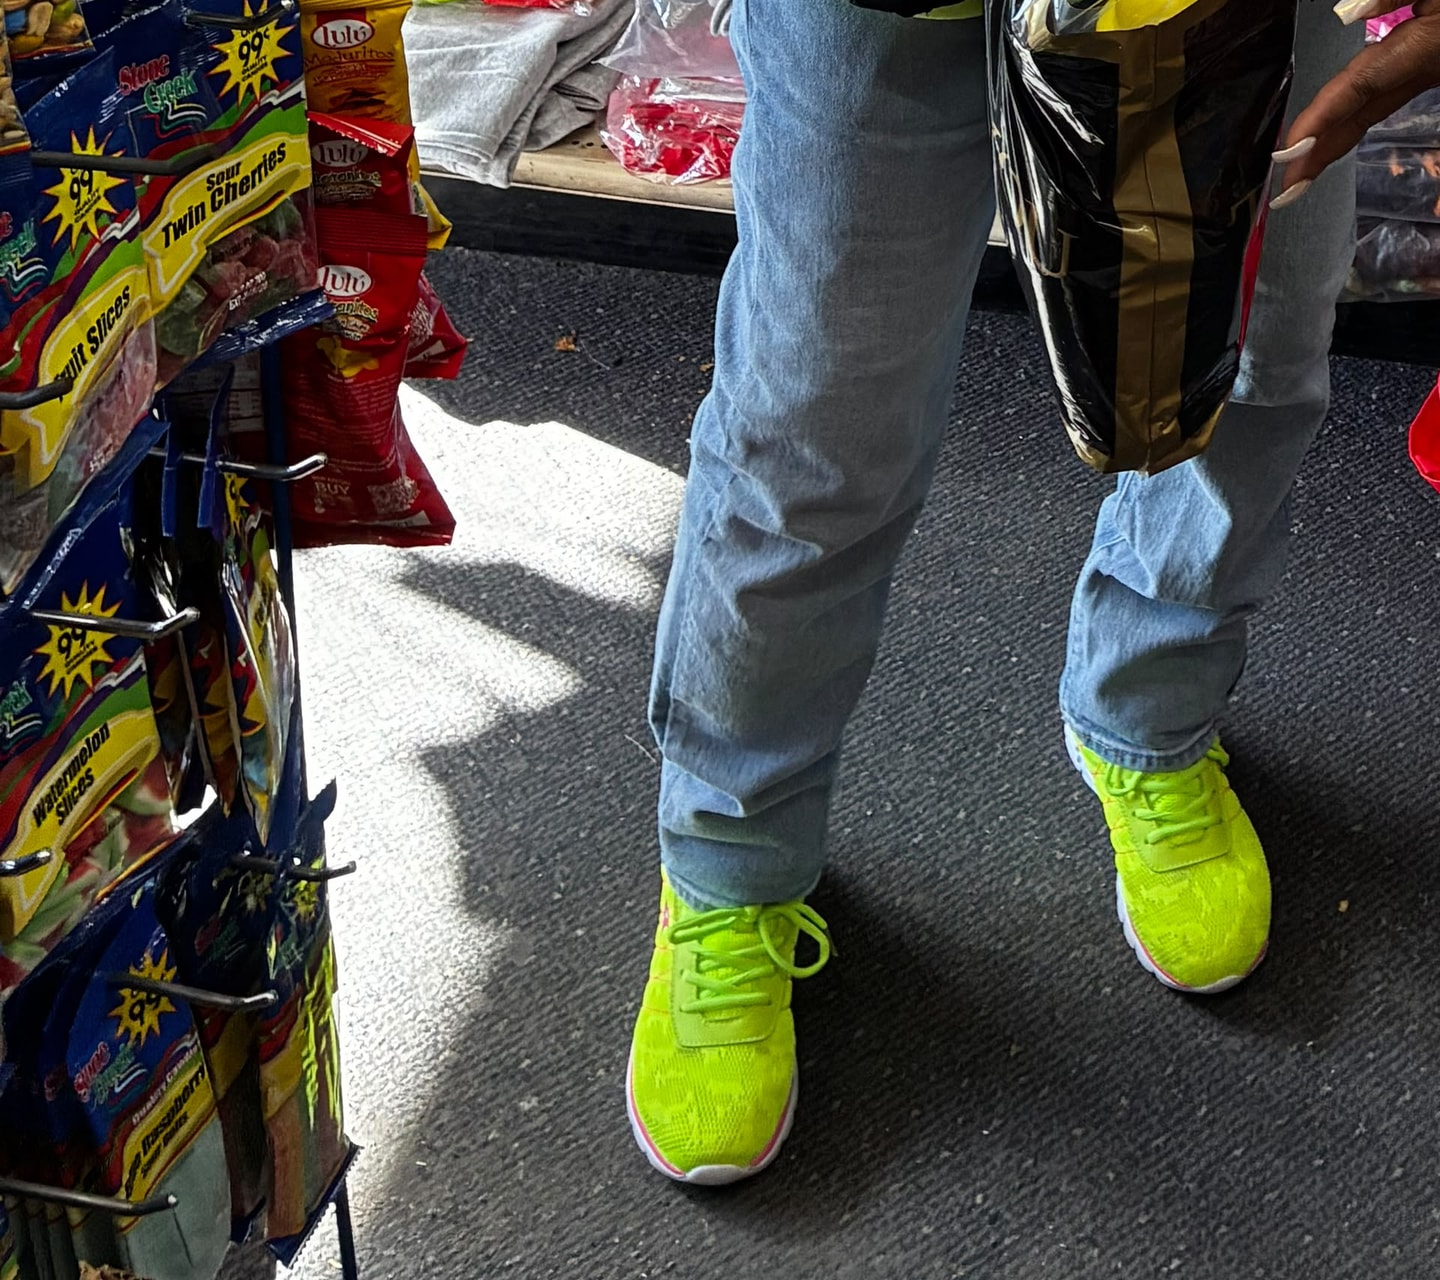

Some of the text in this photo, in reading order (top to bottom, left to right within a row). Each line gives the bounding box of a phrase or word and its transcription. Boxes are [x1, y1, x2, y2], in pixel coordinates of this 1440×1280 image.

[119, 54, 170, 95] Stone
[144, 69, 198, 113] Creek
[161, 201, 207, 249] Twin
[210, 142, 287, 213] Cherries
[206, 161, 242, 192] Sour
[86, 284, 131, 356] Slices
[315, 481, 349, 496] BUY
[31, 721, 111, 828] Watermelon
[57, 767, 95, 827] Slices
